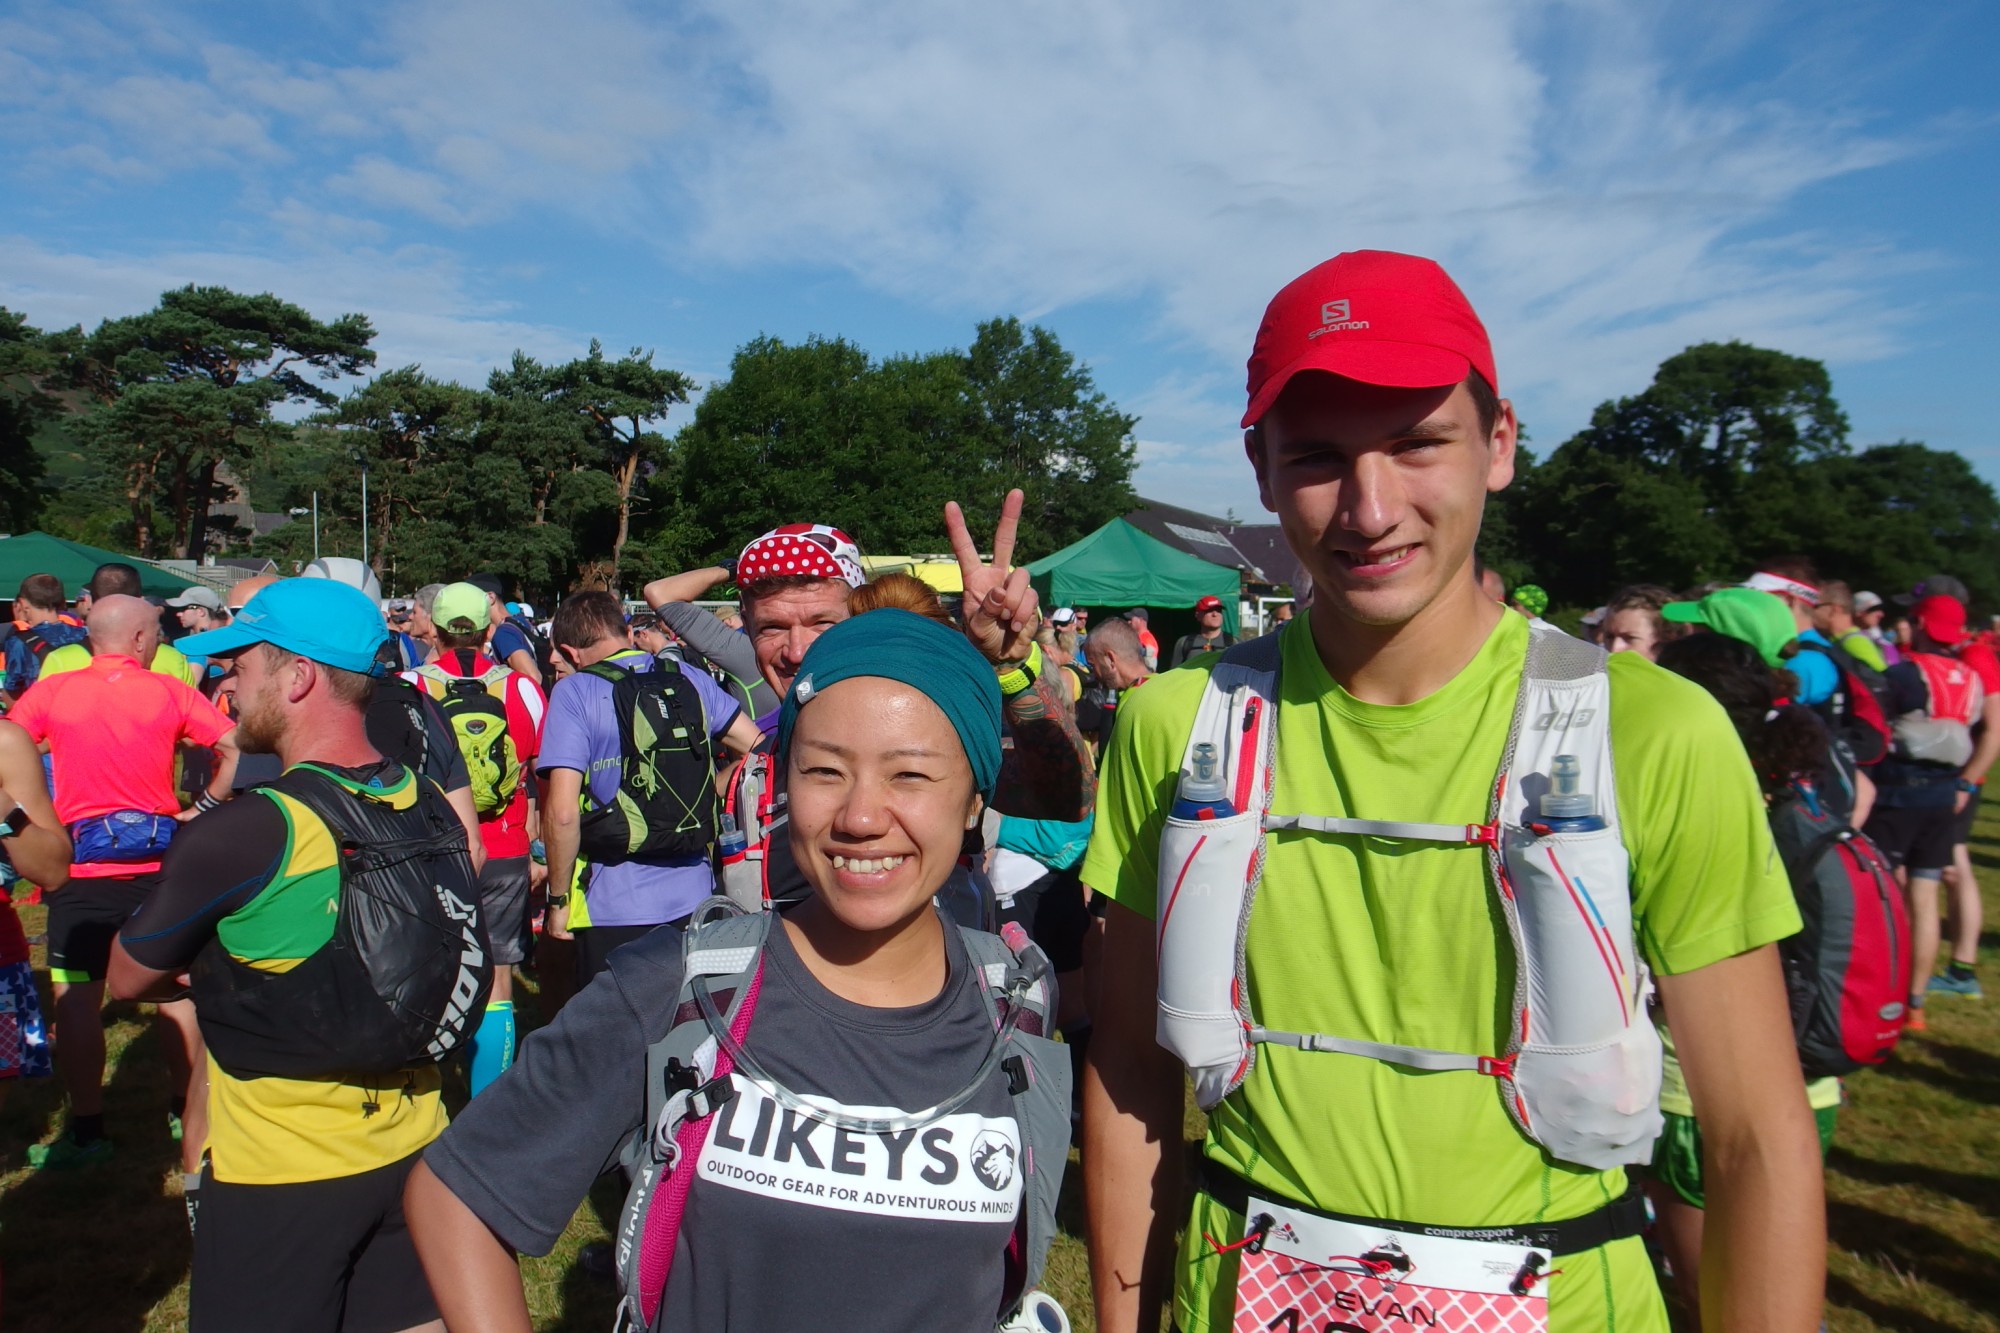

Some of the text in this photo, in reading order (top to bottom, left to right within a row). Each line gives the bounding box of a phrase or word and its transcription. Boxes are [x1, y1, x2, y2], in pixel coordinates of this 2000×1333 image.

[713, 1091, 959, 1186] LIKEYS
[707, 1159, 1014, 1214] OUTDOOR GEAR FOR ADVENTUROUS MINDS
[1424, 1226, 1515, 1240] compressport
[1335, 1290, 1437, 1328] EVAN
